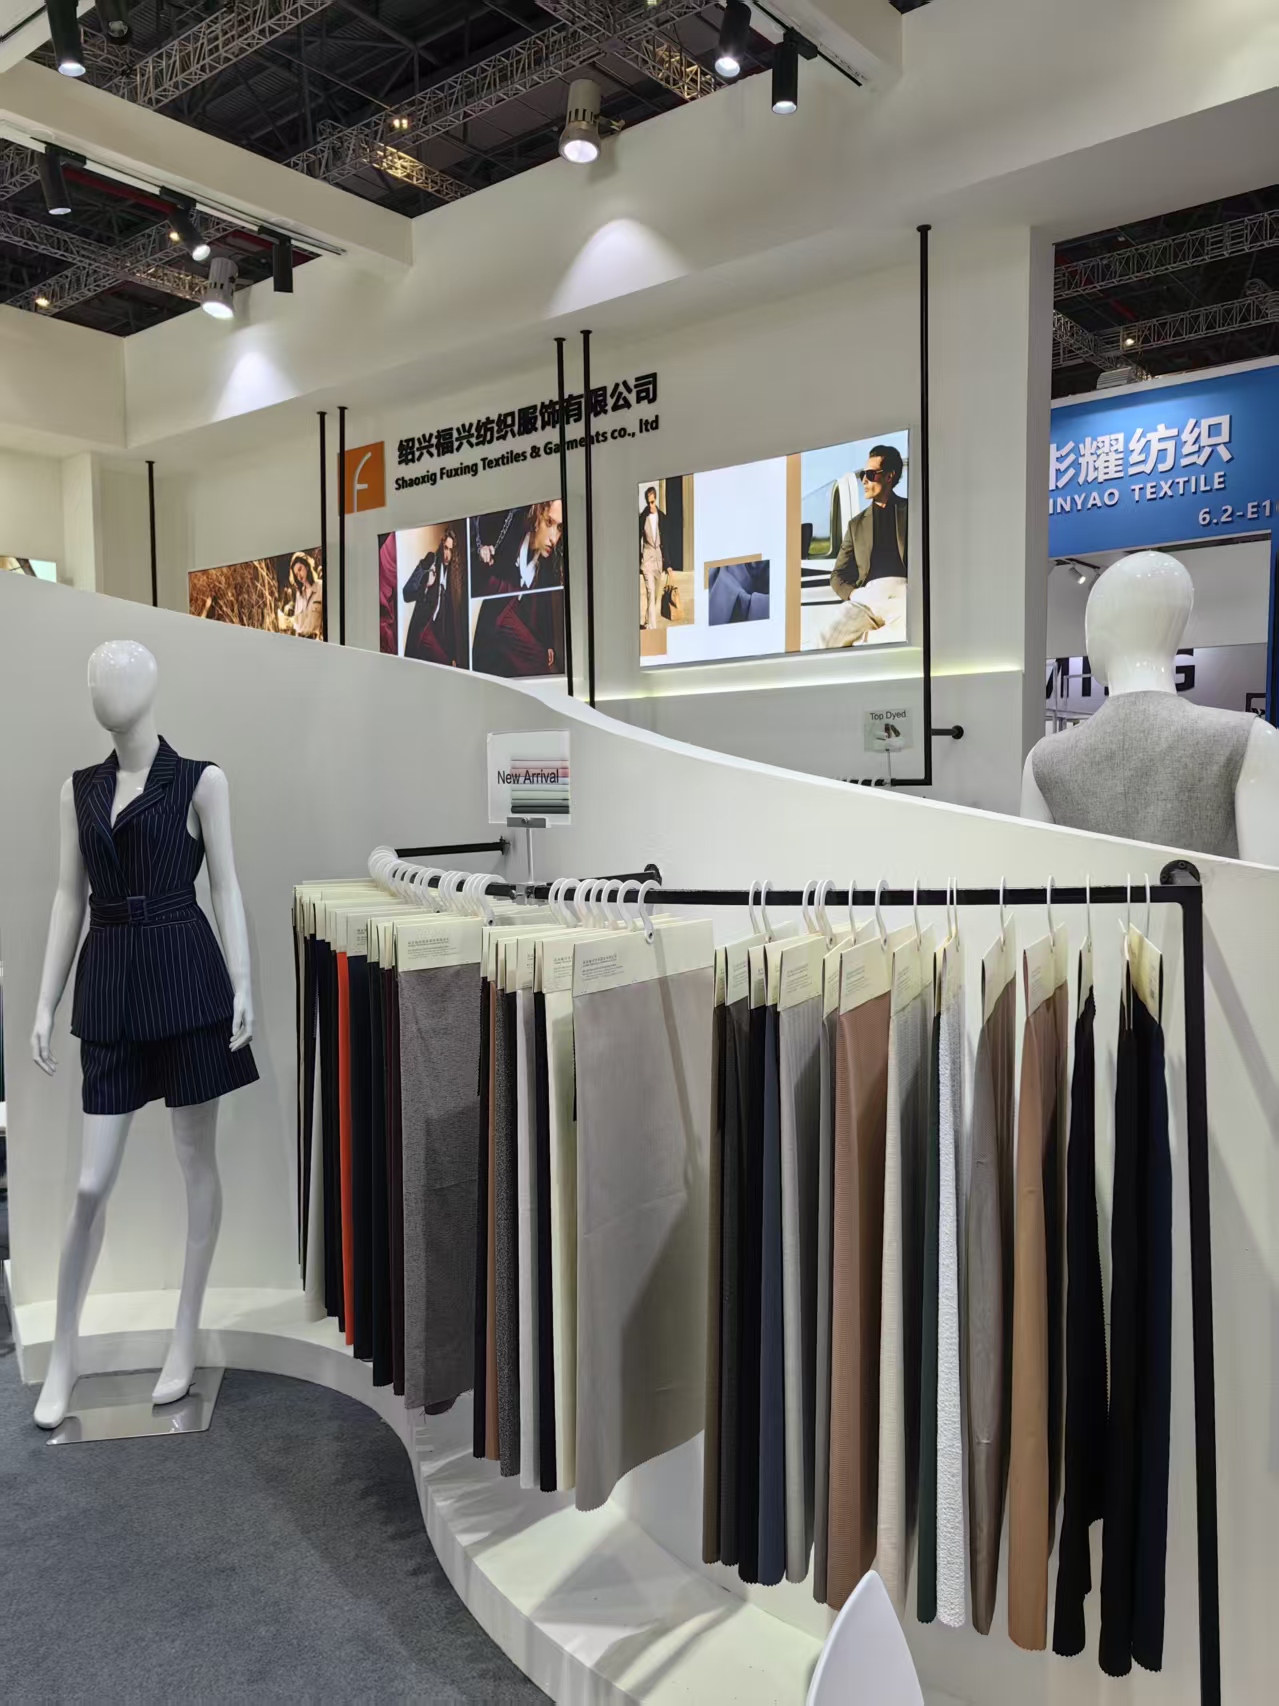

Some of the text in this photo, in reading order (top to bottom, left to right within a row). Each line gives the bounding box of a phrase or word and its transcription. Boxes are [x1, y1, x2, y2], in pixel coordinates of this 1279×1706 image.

[397, 372, 657, 466] 绍兴福兴纺织服饰有限公司
[394, 470, 437, 491] Shaoxig
[439, 462, 478, 480] Fuxing
[480, 450, 527, 470] Textiles
[530, 445, 541, 459] &
[543, 431, 608, 456] Gaments
[639, 414, 659, 434] ltd
[1130, 471, 1226, 502] TEXTILE
[870, 710, 906, 721] Top Dyed
[497, 769, 559, 785] New Arrival
